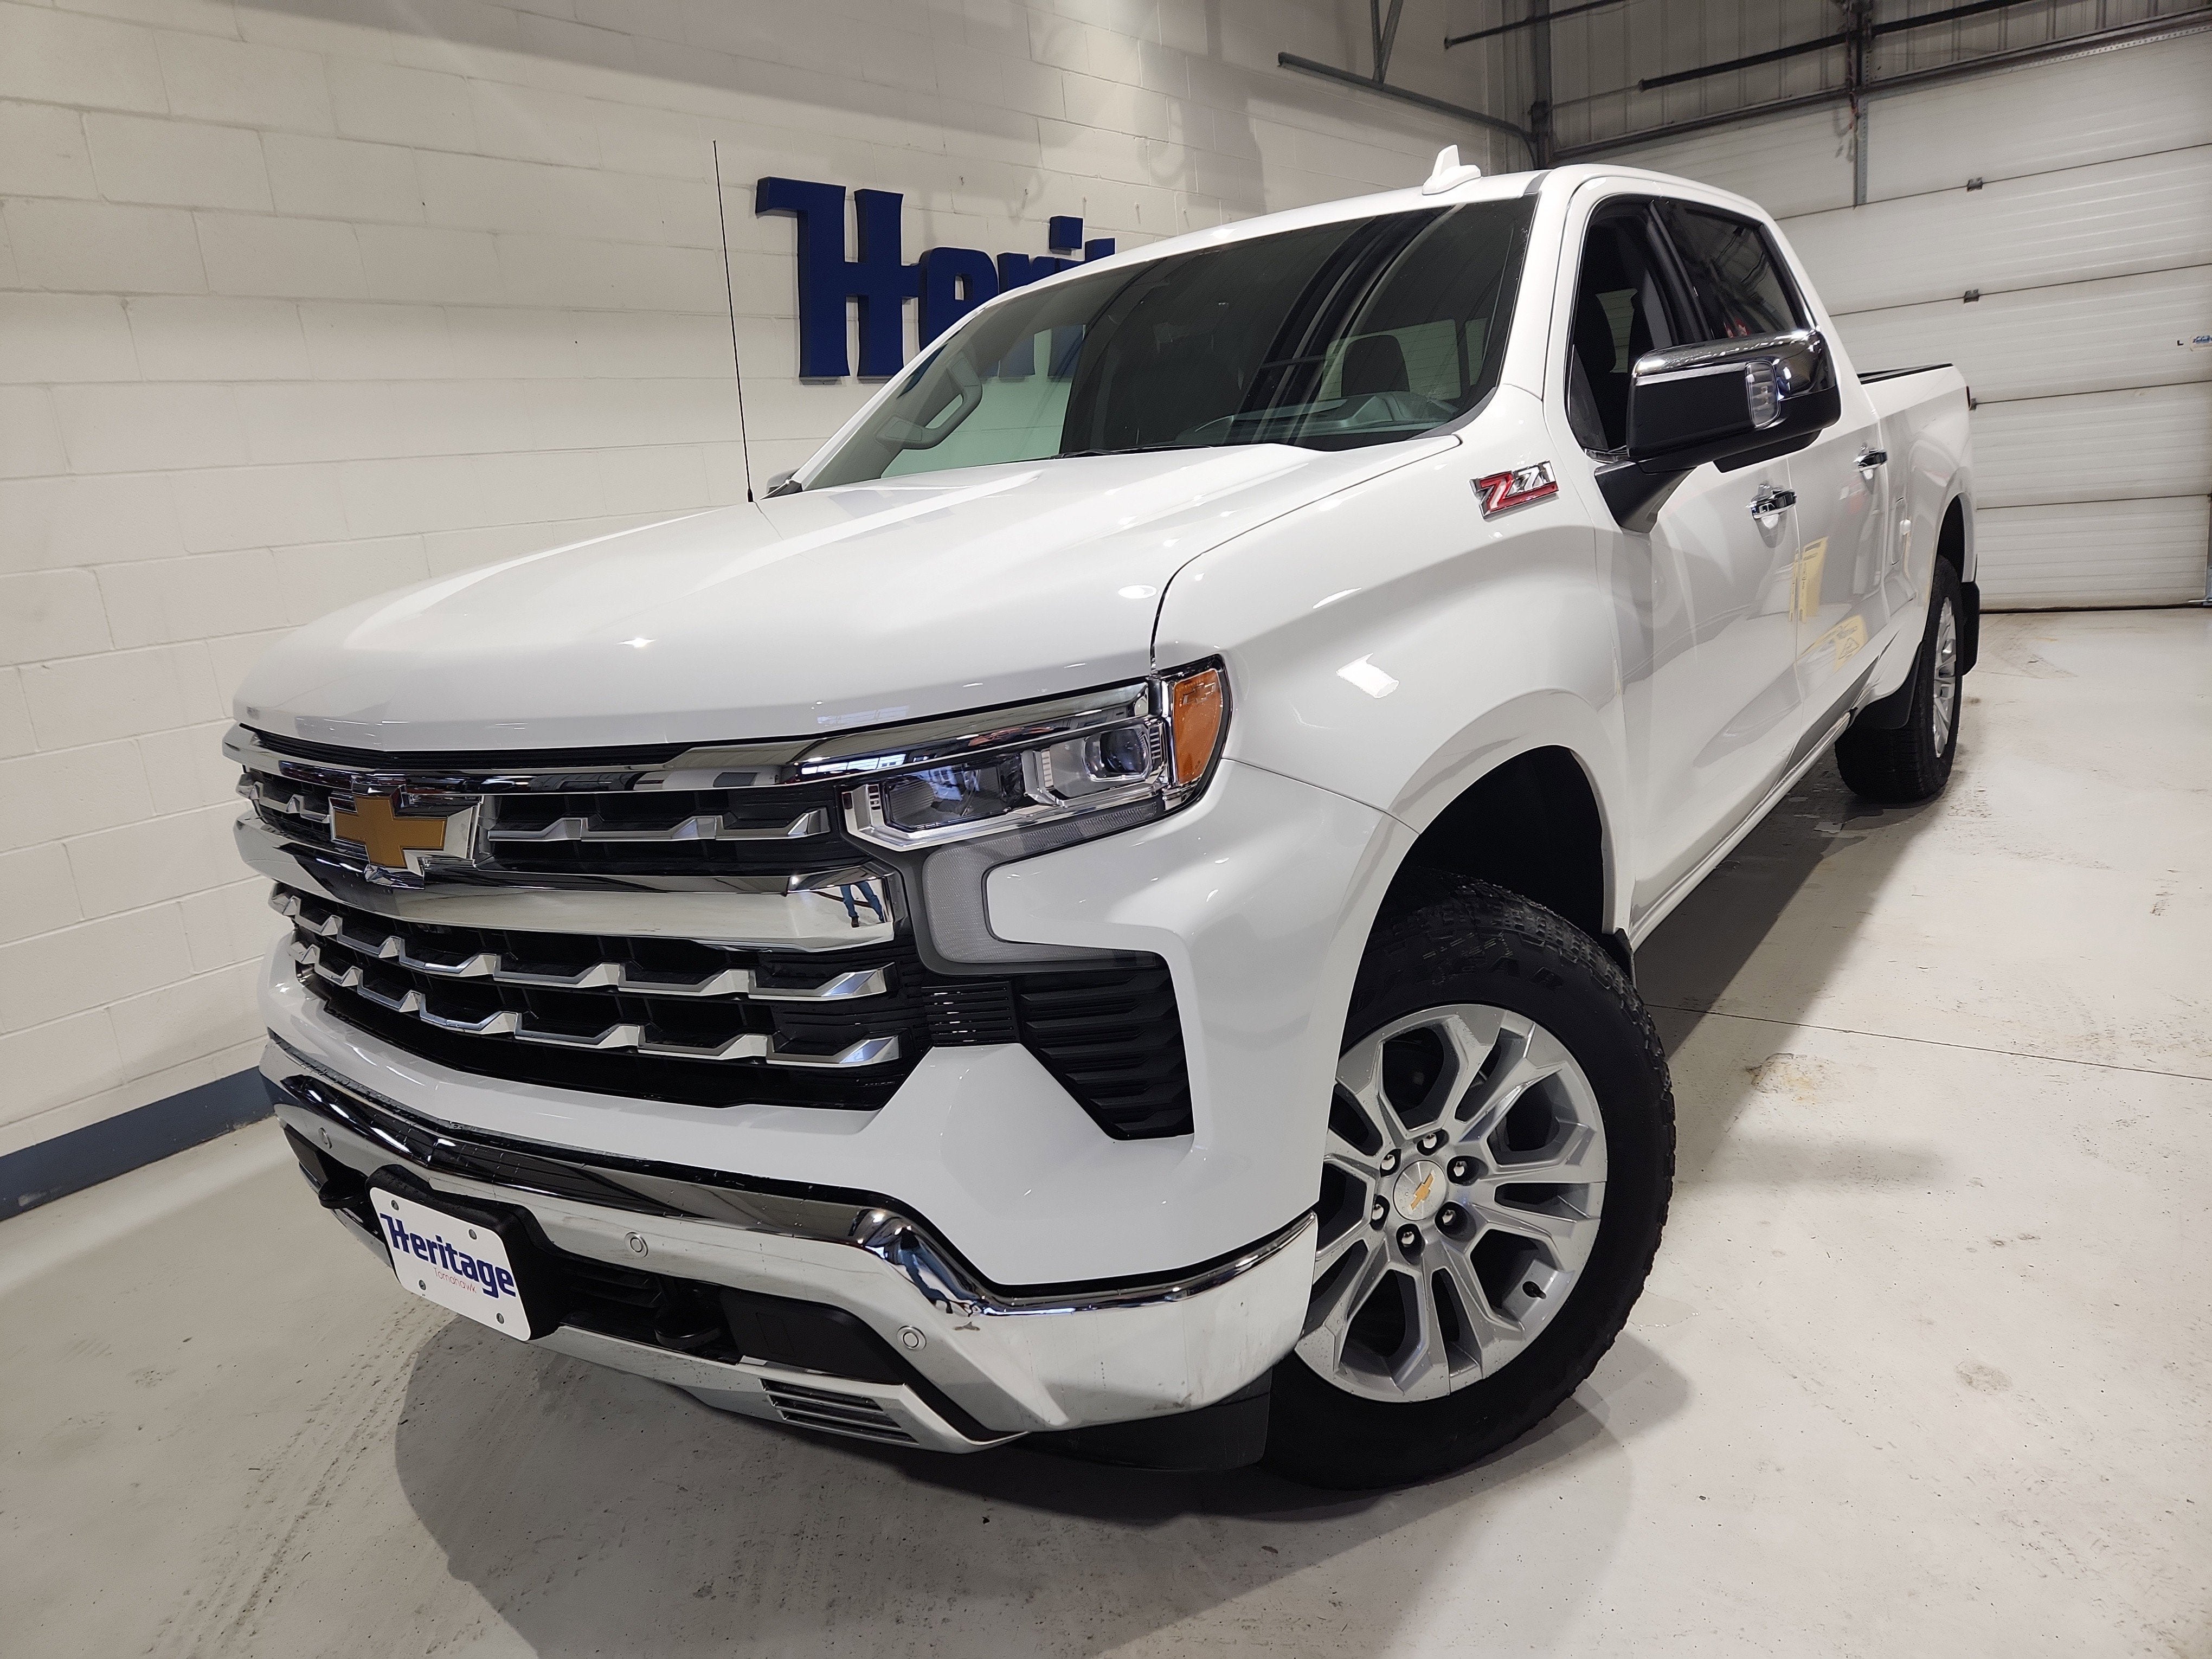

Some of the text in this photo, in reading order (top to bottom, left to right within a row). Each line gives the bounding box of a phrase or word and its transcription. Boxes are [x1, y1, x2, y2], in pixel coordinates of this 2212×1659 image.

[755, 176, 1115, 377] Heri
[1469, 460, 1560, 519] Z71
[380, 1213, 516, 1299] Heritage
[433, 1267, 477, 1294] Tomahawk
